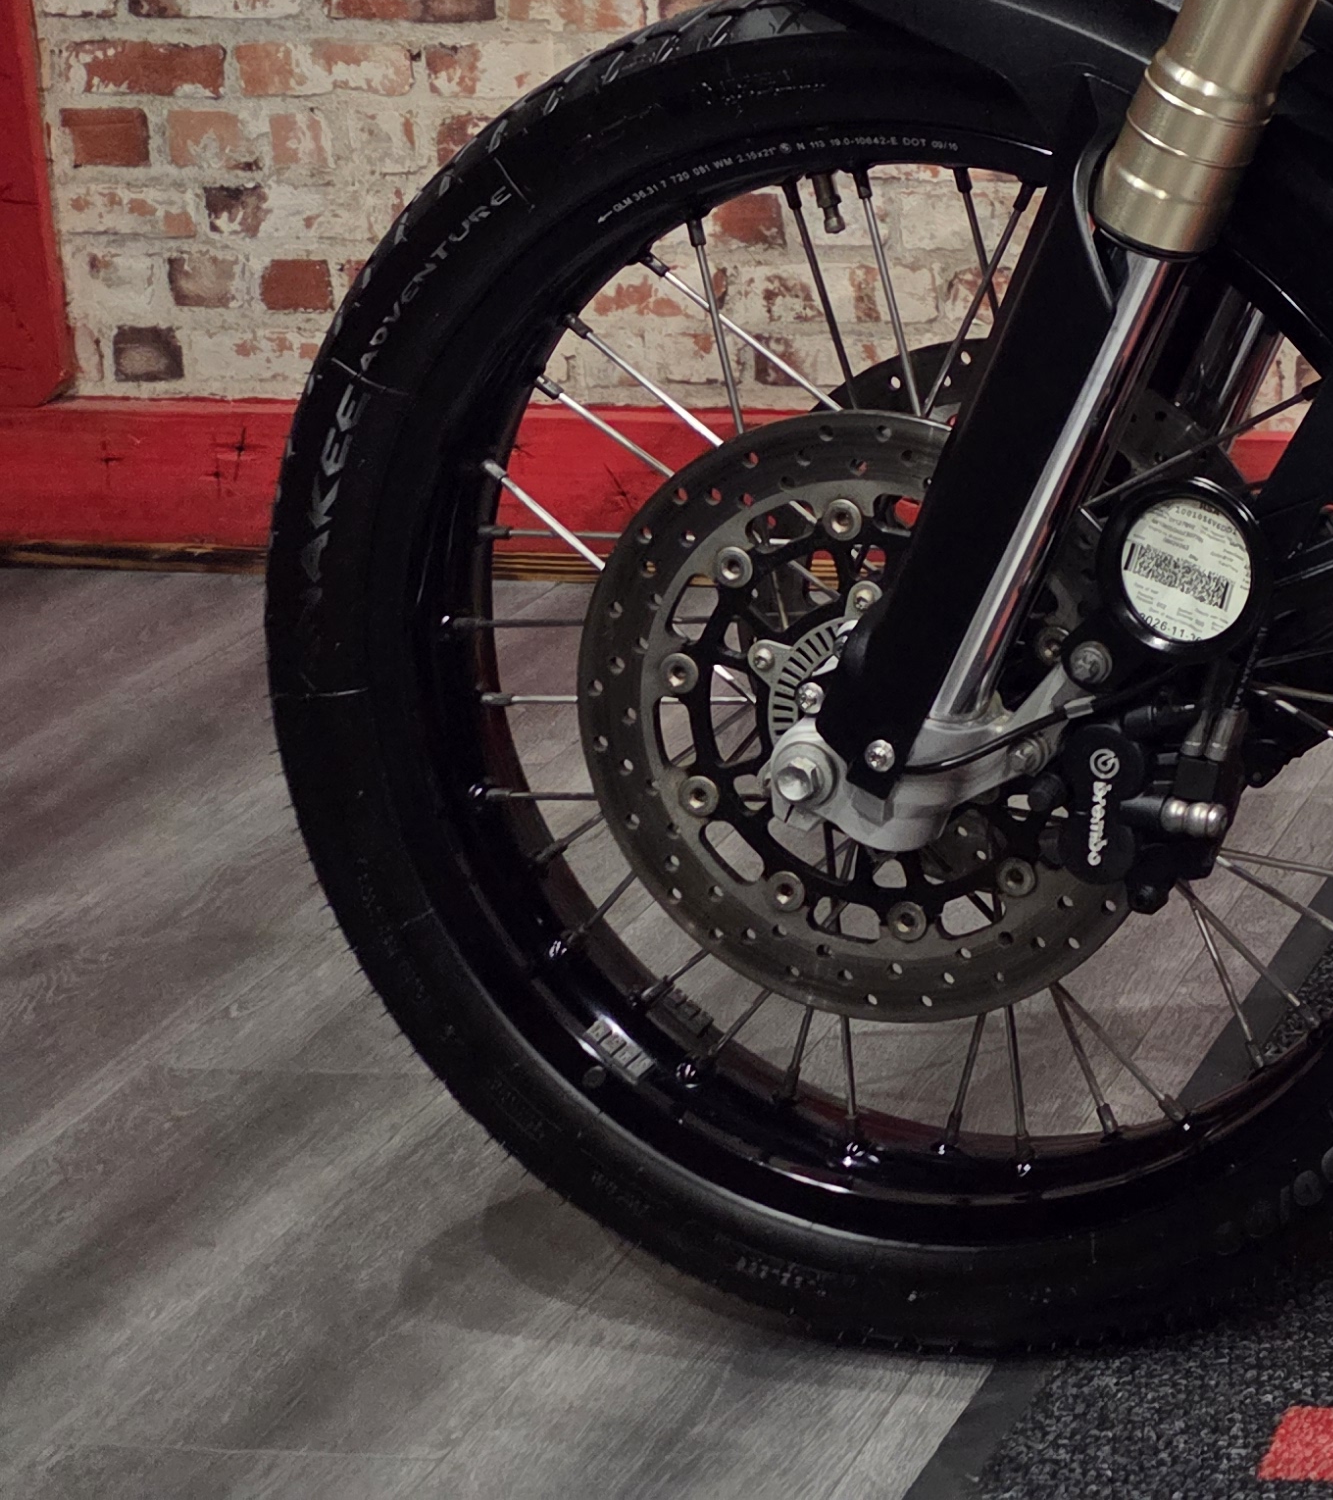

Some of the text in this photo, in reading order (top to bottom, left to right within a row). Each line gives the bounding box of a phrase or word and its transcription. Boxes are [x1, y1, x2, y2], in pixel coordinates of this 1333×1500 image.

[902, 137, 927, 147] DOT
[300, 185, 513, 610] AKEE ADVENTURE
[1086, 780, 1113, 867] brembo
